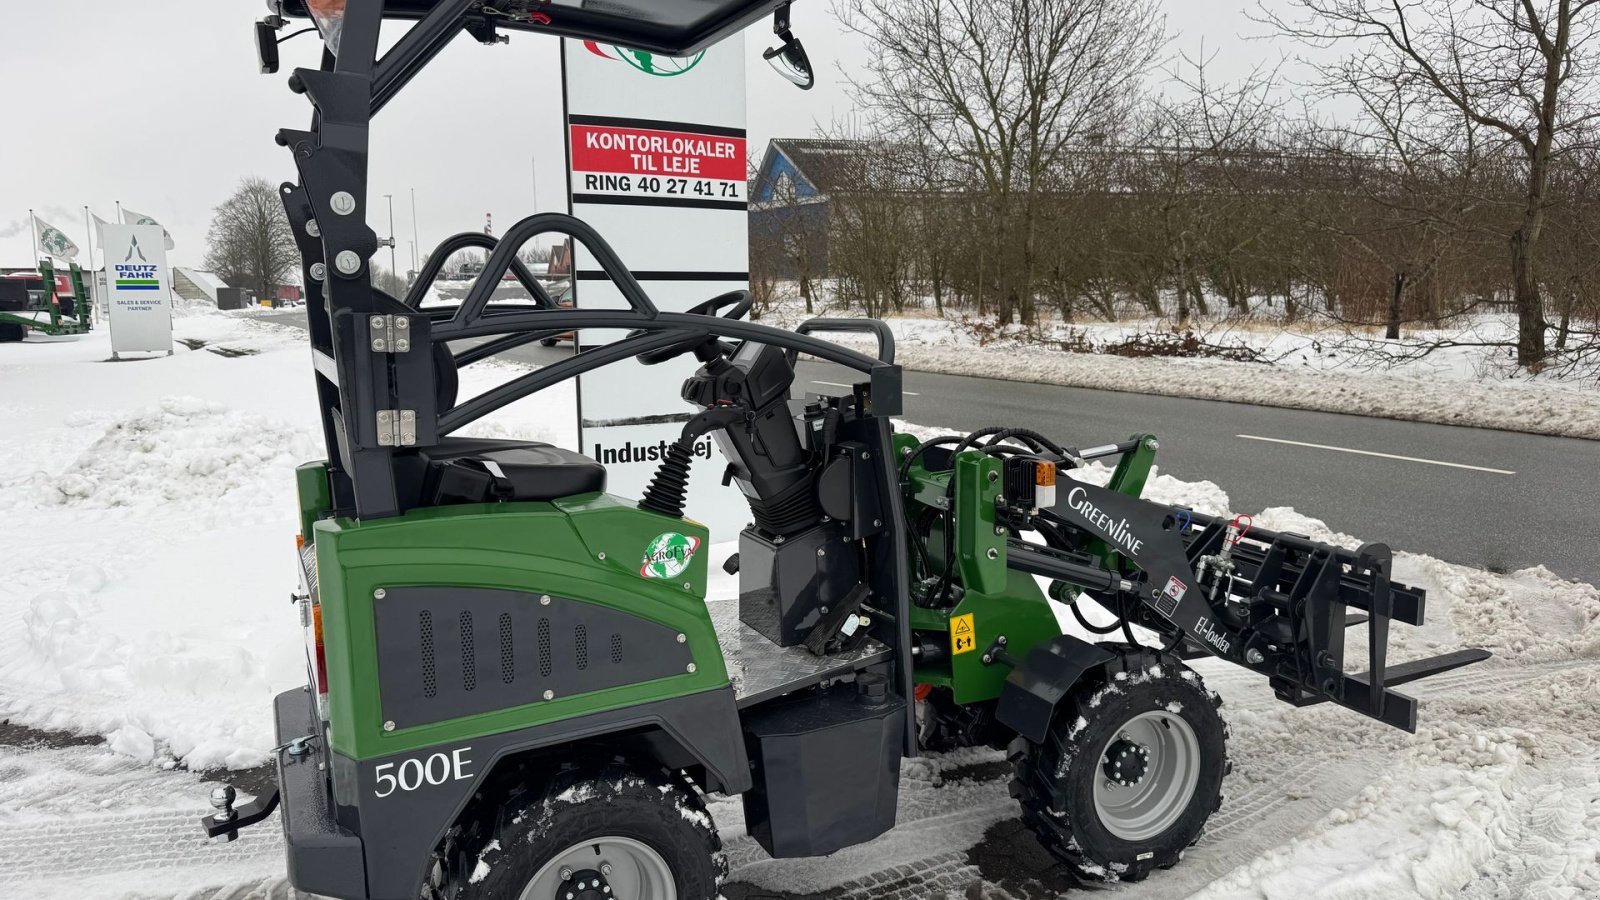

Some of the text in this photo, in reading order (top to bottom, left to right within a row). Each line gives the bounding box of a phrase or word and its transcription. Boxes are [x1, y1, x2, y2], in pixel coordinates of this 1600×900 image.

[586, 132, 735, 159] KONTORLOKALER
[630, 154, 700, 174] TIL LEJE
[585, 174, 739, 198] RING 40 27 41 71
[595, 435, 712, 465] Industej
[374, 746, 474, 798] 500E
